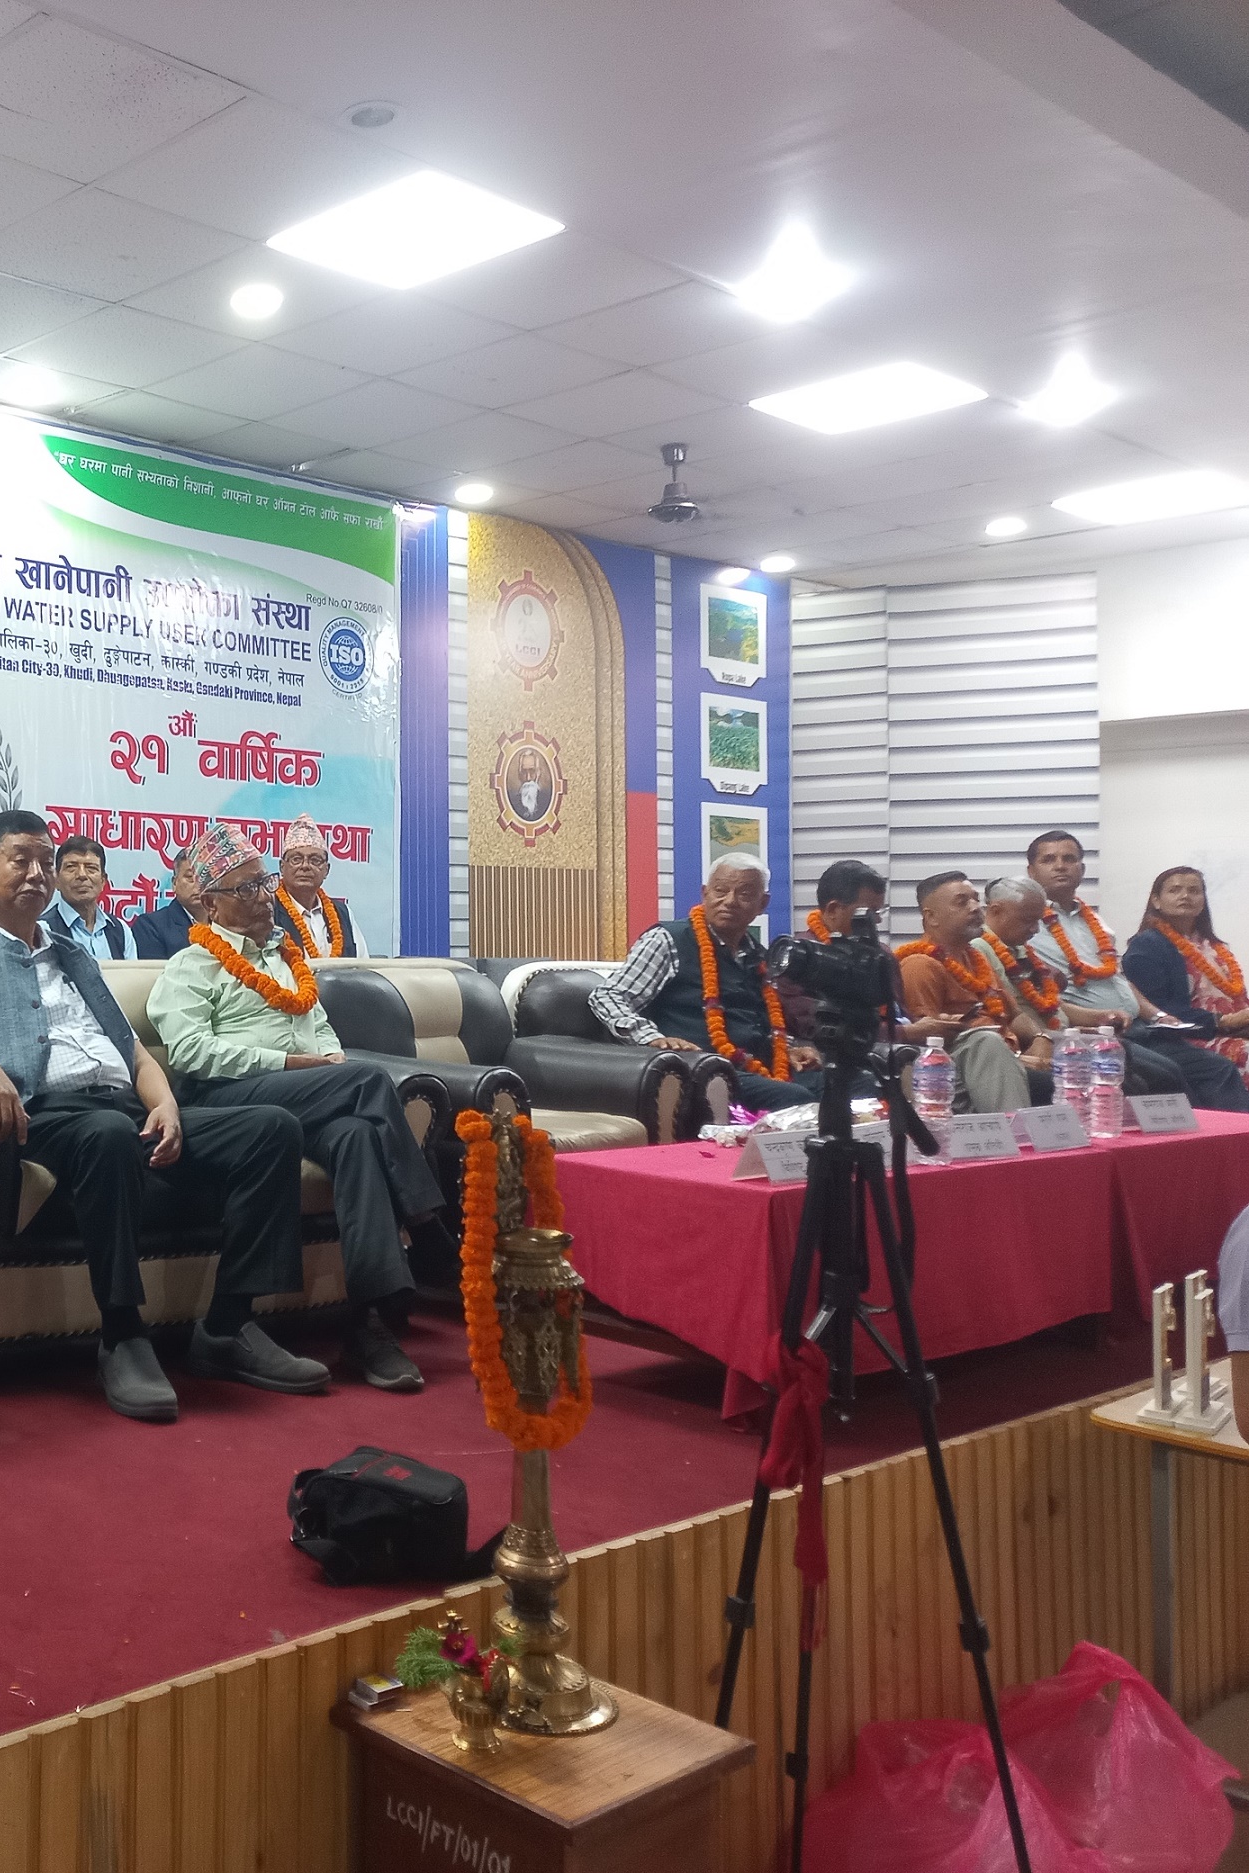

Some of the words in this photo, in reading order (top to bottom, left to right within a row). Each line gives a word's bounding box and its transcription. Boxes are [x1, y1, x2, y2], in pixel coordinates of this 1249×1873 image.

[80, 456, 107, 474] घरमा
[111, 463, 133, 479] पानी
[137, 469, 180, 489] सभ्यताको
[255, 494, 269, 510] घर
[15, 555, 133, 604] खानेपानी
[251, 593, 312, 632] संस्था
[306, 593, 326, 607] Regd
[3, 597, 74, 628] WATER
[80, 608, 153, 639] SUPPLY
[160, 619, 206, 647] USER
[212, 629, 312, 662] COMMITTEE
[320, 632, 328, 667] QUALITY
[327, 619, 365, 637] MANAGEMENT
[204, 659, 242, 680] गण्डकी
[246, 664, 272, 687] प्रदेश,
[277, 667, 305, 689] नेपाल
[330, 643, 364, 666] ISO
[64, 664, 96, 684] Khudi,
[234, 687, 275, 706] Province,
[276, 692, 302, 708] Nepal
[110, 730, 168, 785] २१
[197, 730, 324, 788] वार्षिक
